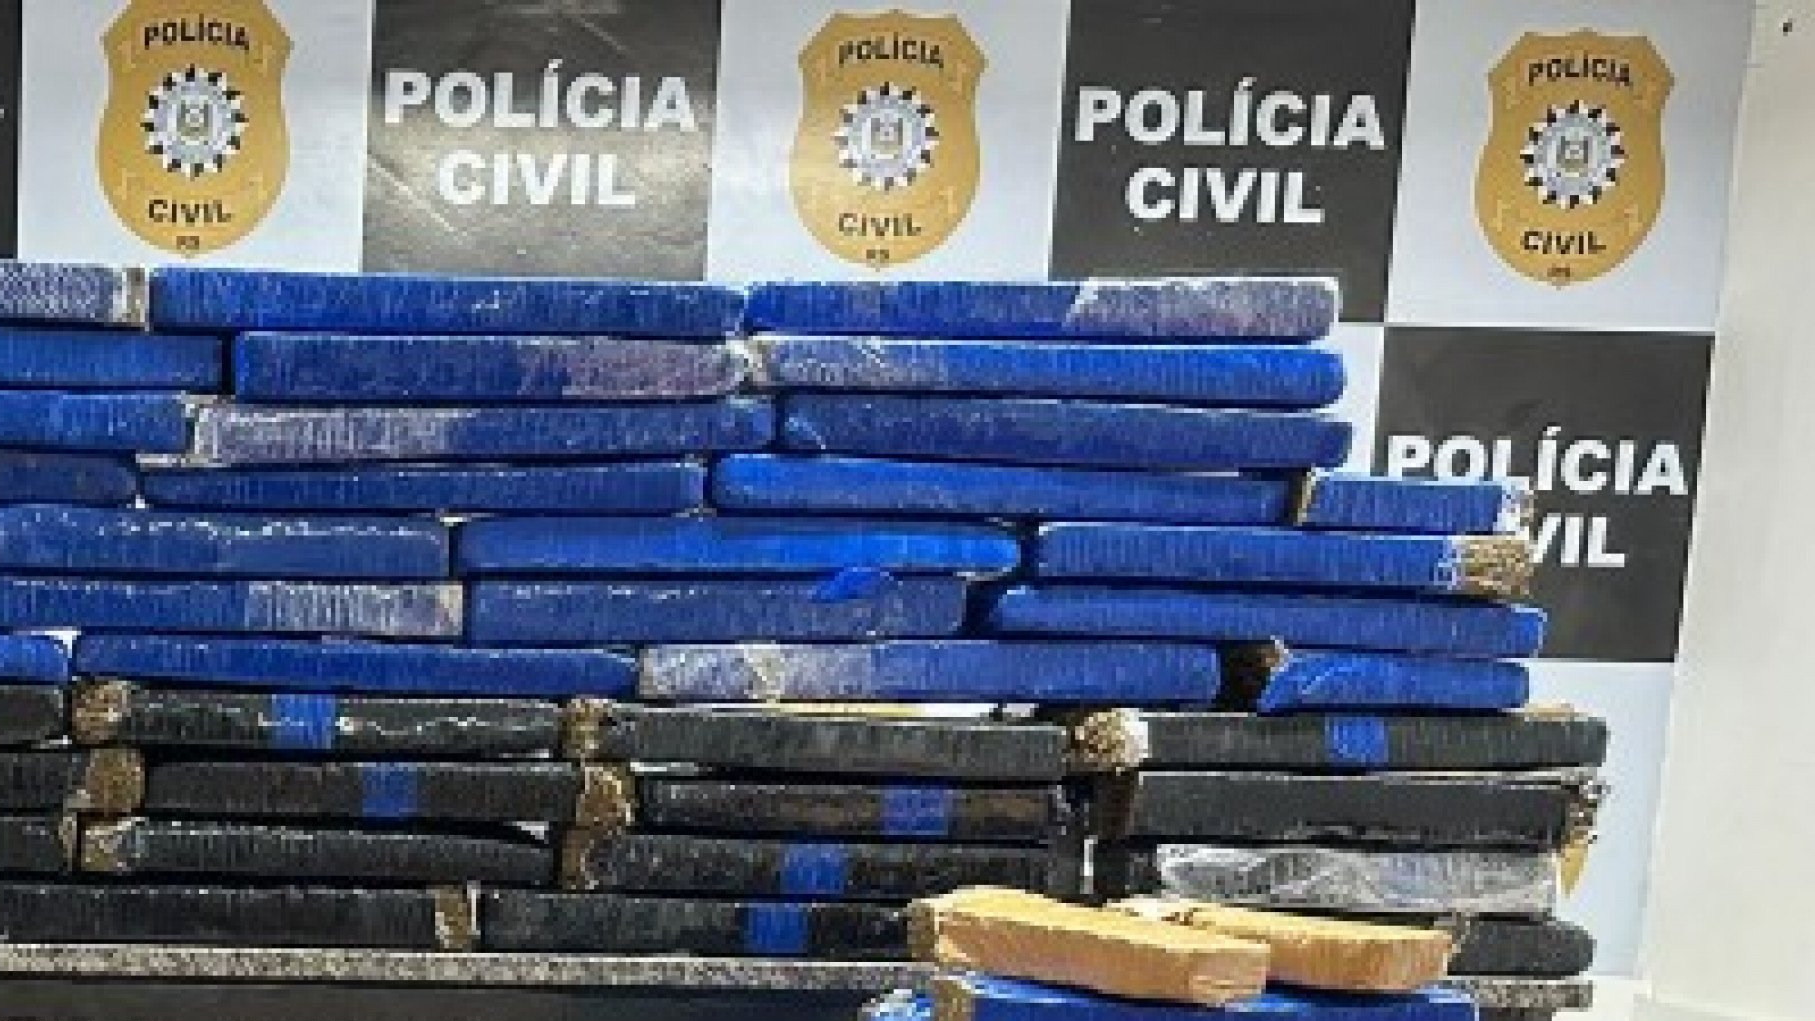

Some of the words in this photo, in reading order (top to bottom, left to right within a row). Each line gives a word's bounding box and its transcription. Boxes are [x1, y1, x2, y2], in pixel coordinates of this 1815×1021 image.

[383, 58, 697, 131] POLÍCIA
[1074, 76, 1387, 151] POLÍCIA
[438, 150, 636, 205] CIVIL
[1126, 167, 1325, 223] CIVIL
[148, 199, 232, 225] CIVIL
[838, 212, 922, 237] CIVIL
[1520, 231, 1607, 255] CIVIL
[1387, 425, 1688, 495] POLÍCIA
